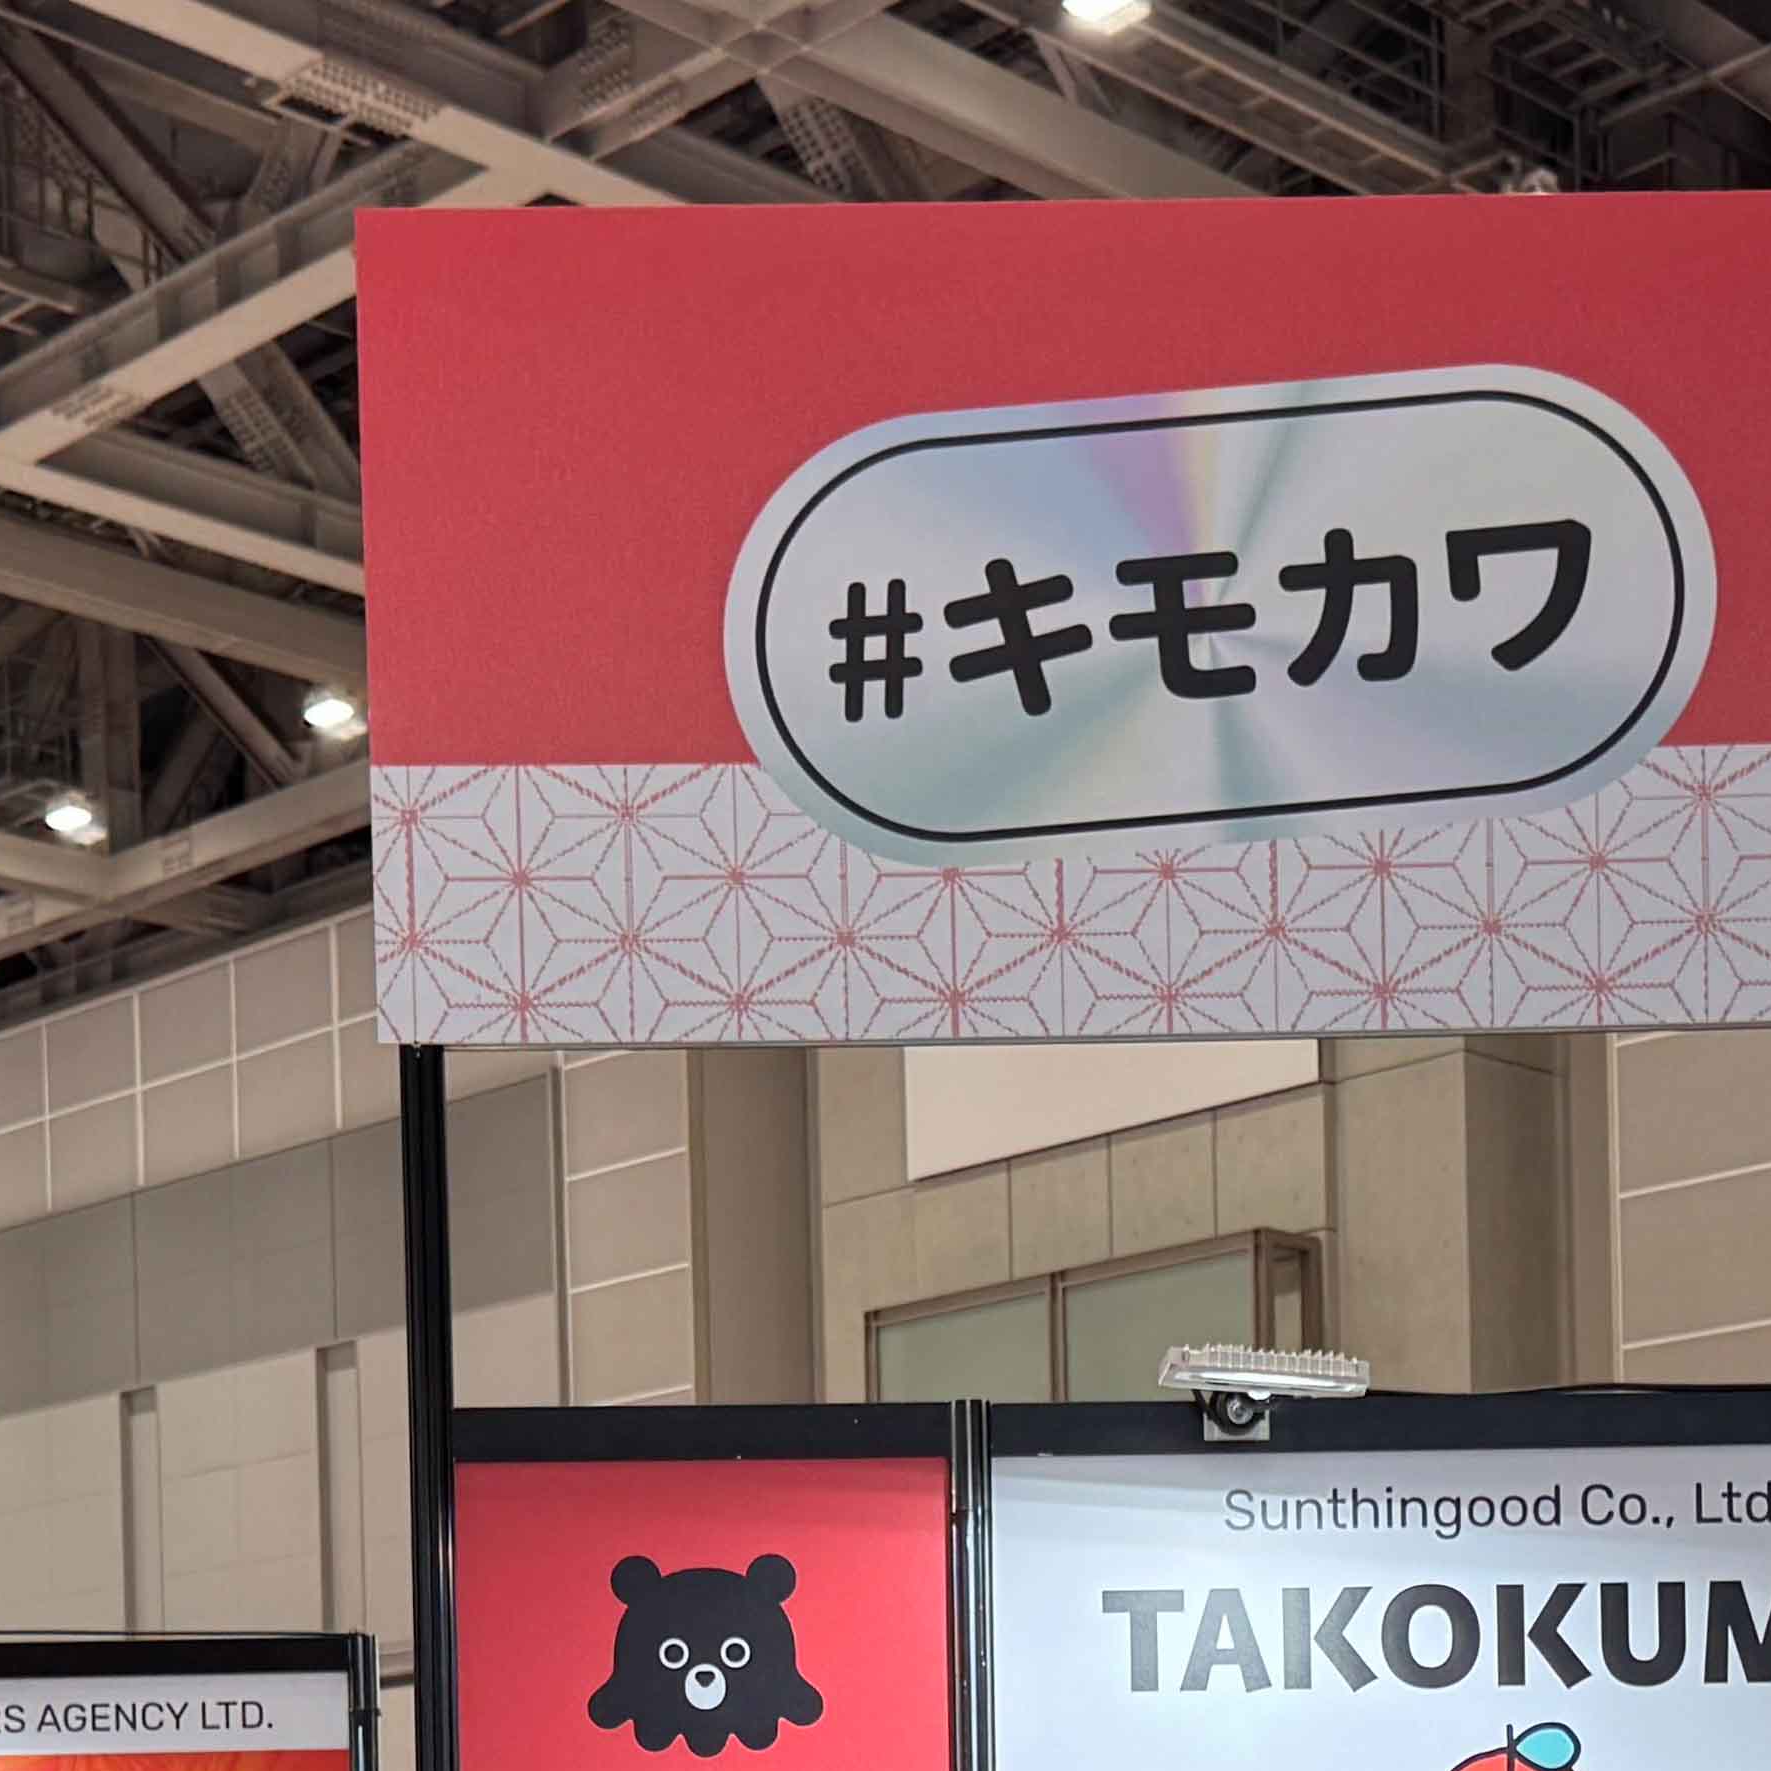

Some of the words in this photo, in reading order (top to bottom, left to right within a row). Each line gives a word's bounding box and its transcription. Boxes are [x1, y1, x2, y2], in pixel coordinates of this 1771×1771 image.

[829, 518, 1592, 724] #キモカワ
[1223, 1485, 1563, 1540] Sunthingood
[1580, 1482, 1677, 1532] Co.,
[36, 1701, 190, 1733] AGENCY
[200, 1699, 274, 1731] LTD.
